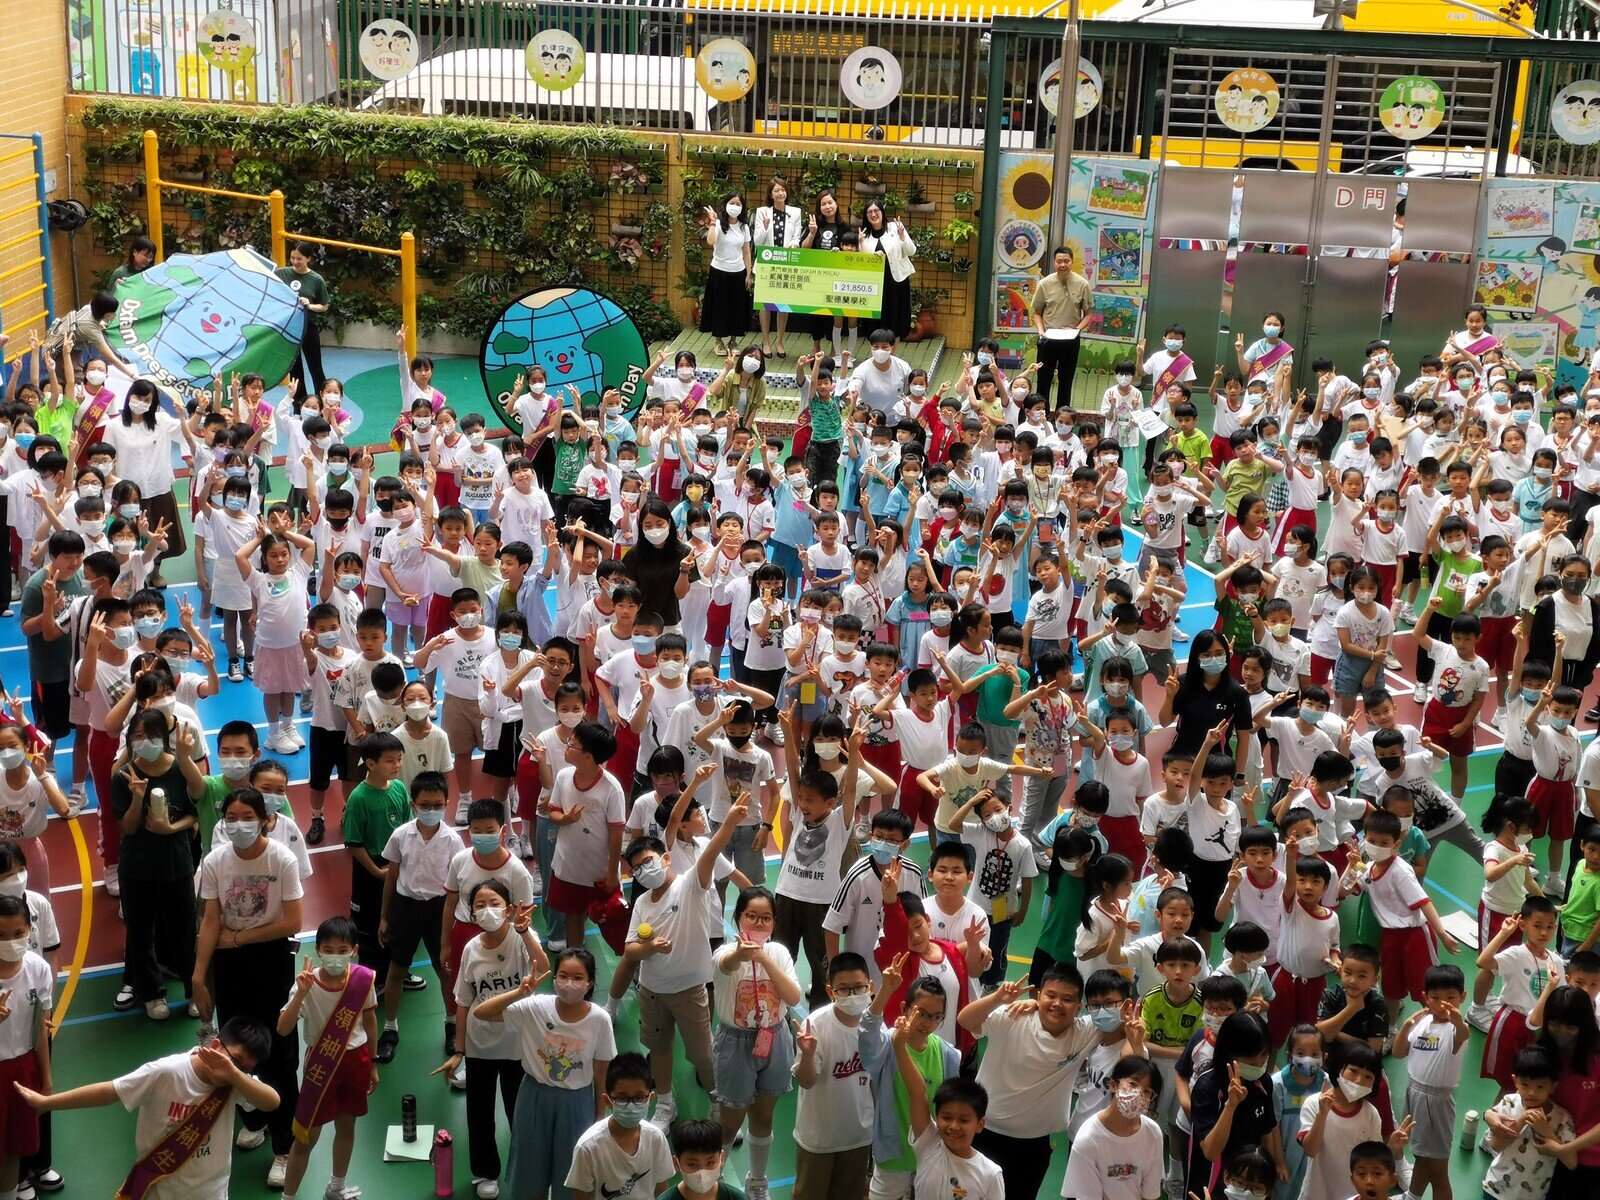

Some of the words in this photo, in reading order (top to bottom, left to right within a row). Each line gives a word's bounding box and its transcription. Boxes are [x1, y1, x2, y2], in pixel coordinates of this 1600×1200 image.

[1336, 187, 1354, 207] D
[1363, 188, 1387, 210] 門
[841, 284, 873, 293] 21,850.5
[119, 299, 141, 345] Oxfam
[131, 341, 173, 387] Dress
[620, 364, 645, 396] Day
[813, 871, 825, 881] APE
[306, 1005, 357, 1087] 領袖生
